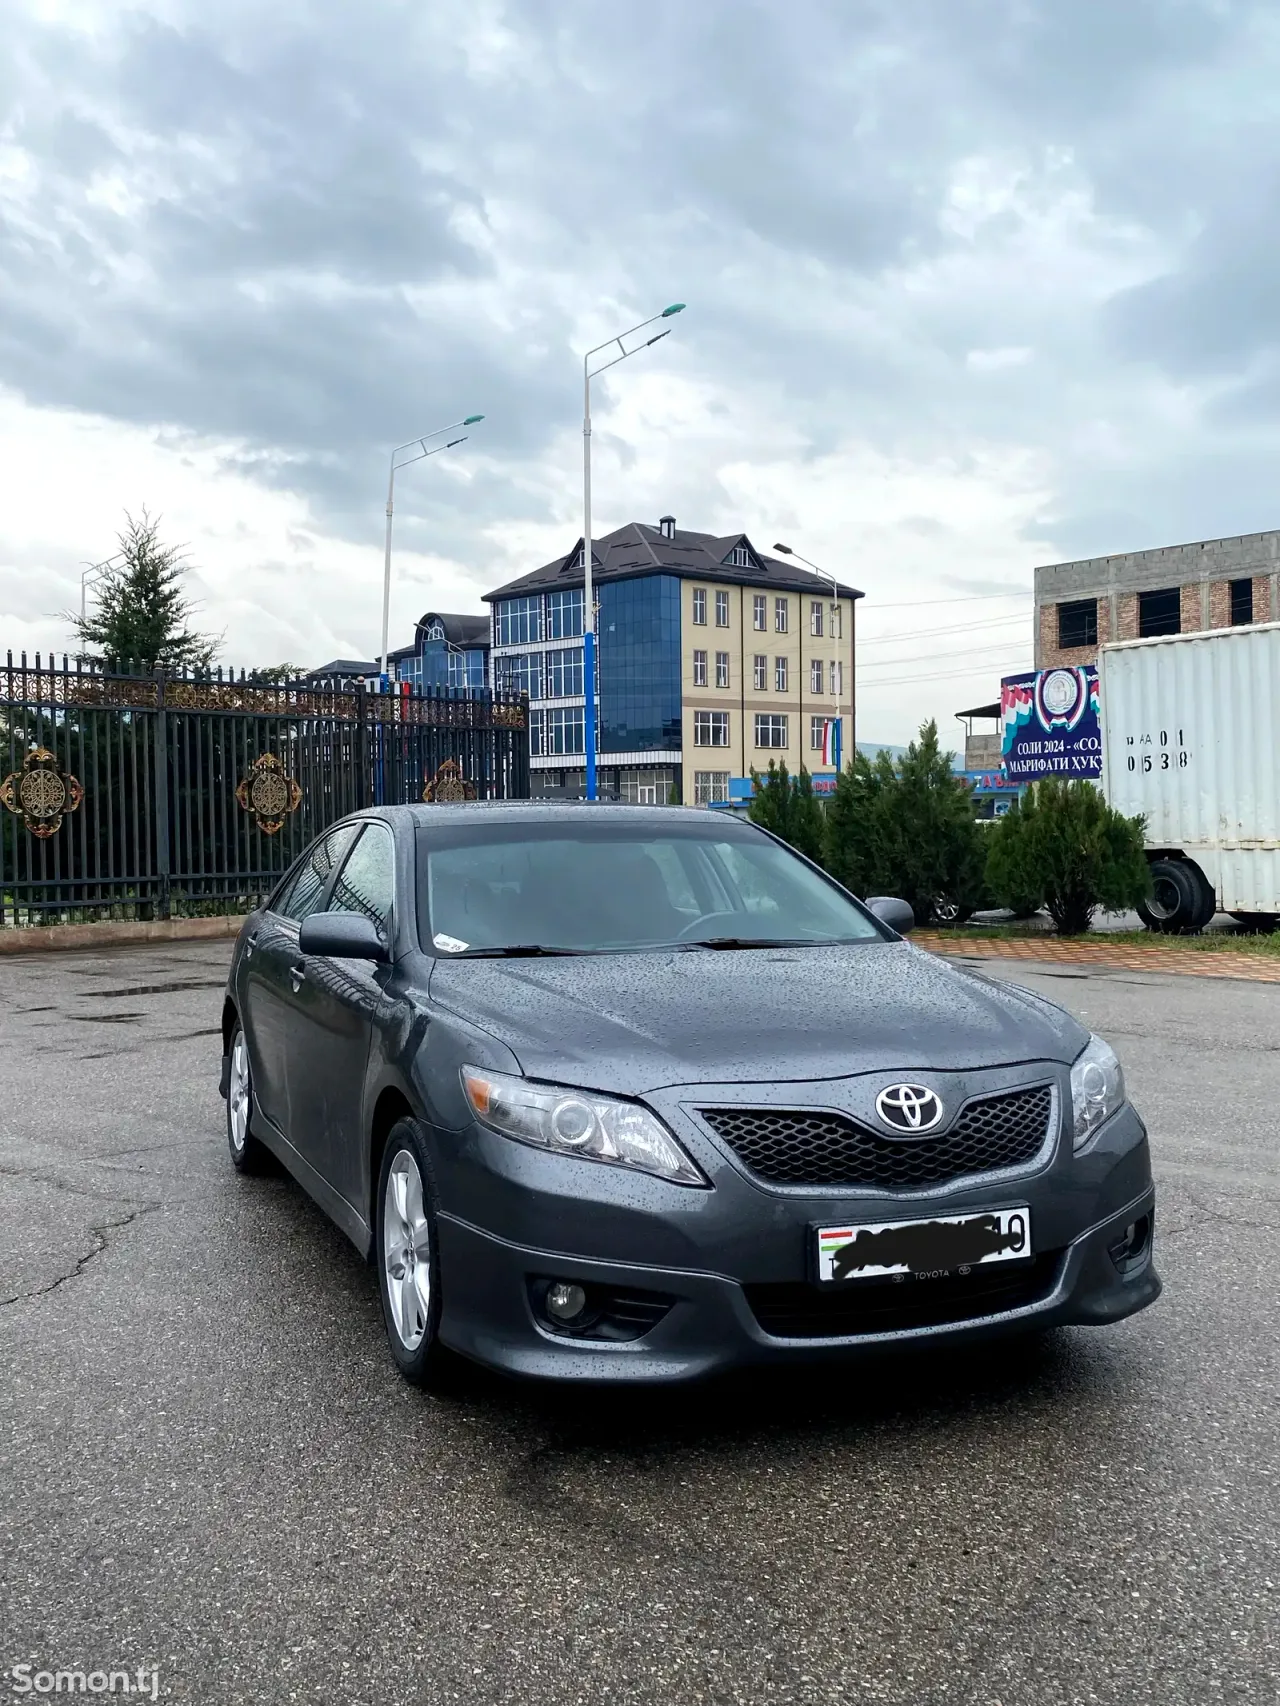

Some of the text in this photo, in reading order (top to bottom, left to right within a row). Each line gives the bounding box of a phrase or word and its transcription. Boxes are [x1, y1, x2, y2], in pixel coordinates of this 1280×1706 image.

[1160, 729, 1184, 747] 01
[1017, 741, 1042, 756] СОЛИ
[1043, 739, 1065, 754] 2024
[1009, 755, 1103, 774] МАЪРИФАТИ ҲУҚ
[1127, 751, 1188, 773] 0538
[914, 1269, 950, 1281] TOYOTA
